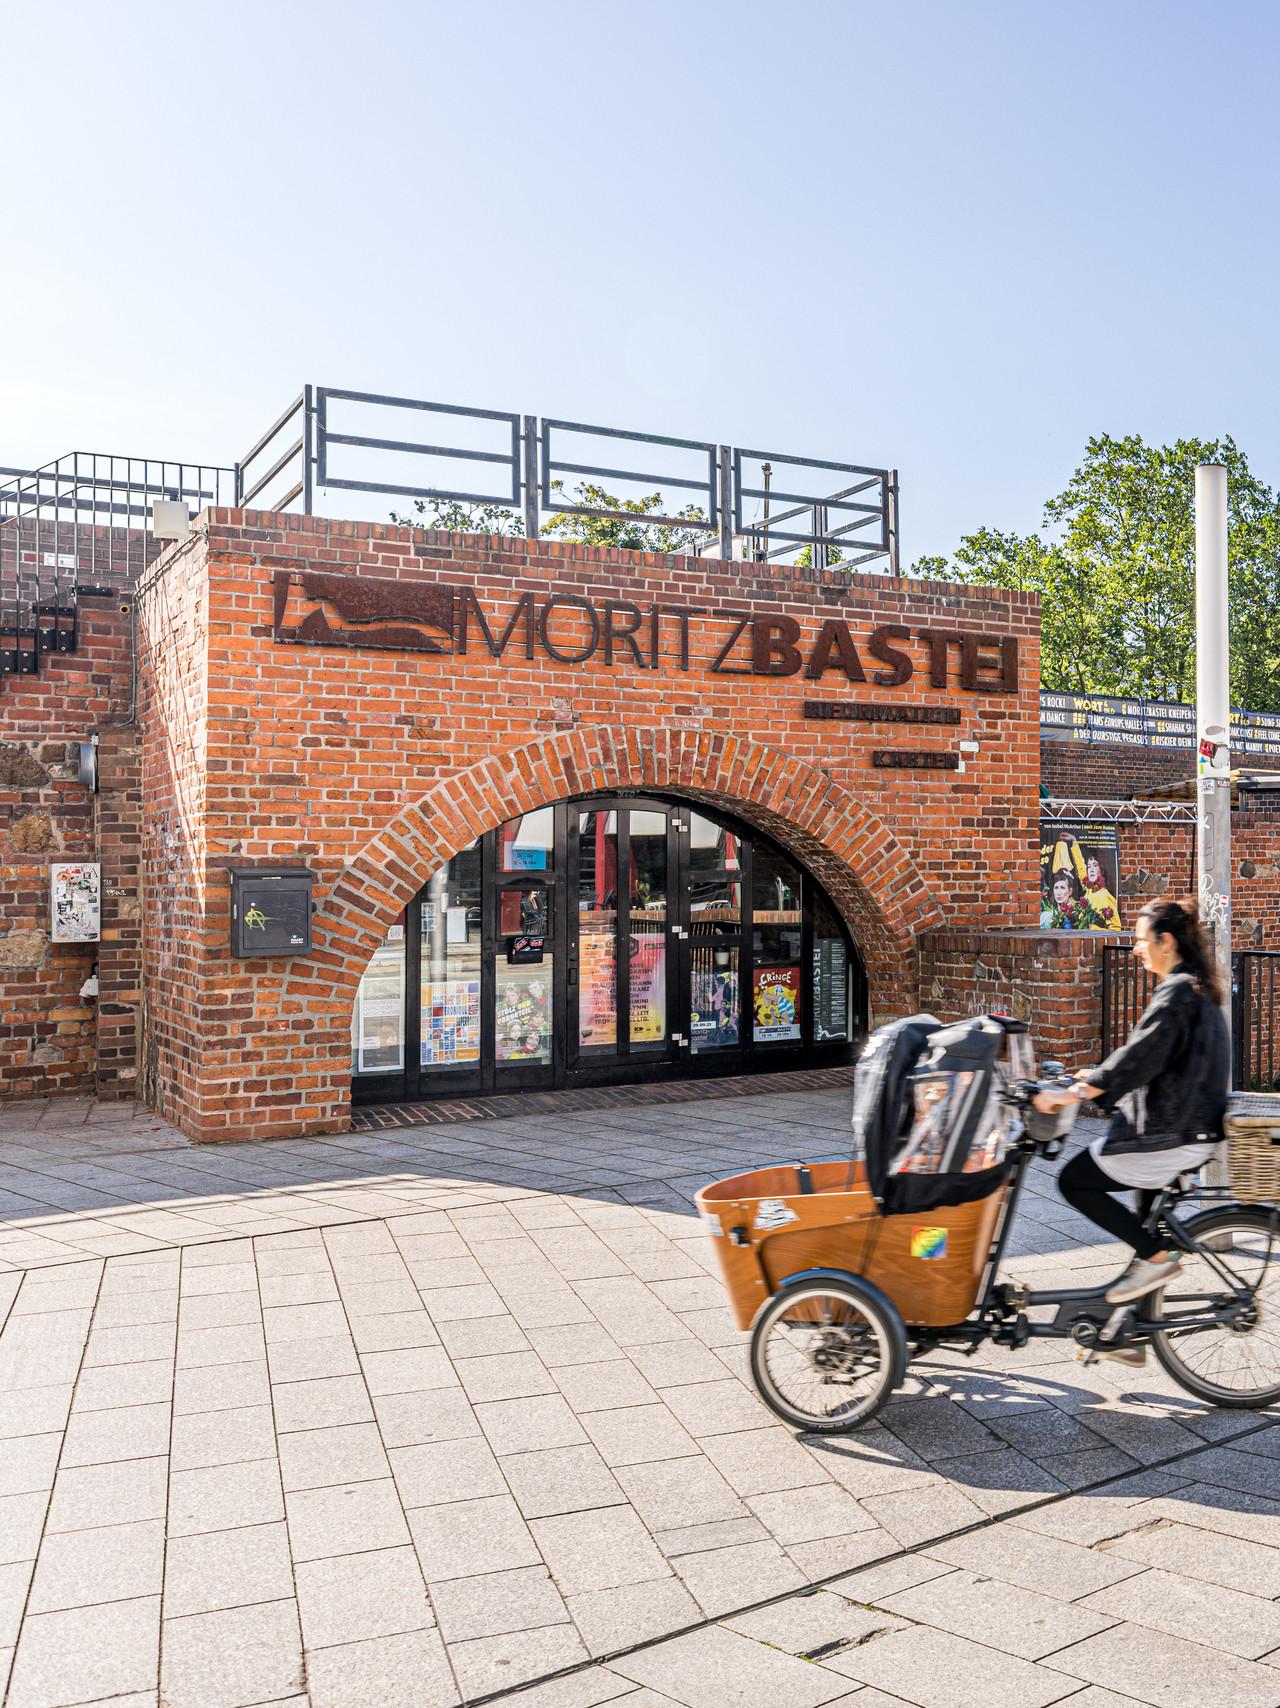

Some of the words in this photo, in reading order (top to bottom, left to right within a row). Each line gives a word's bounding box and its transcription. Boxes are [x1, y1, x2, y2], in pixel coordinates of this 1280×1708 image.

[458, 586, 1019, 693] MORITZBASTEI
[804, 702, 960, 723] INFORMATION
[1073, 697, 1103, 712] WORT
[1229, 713, 1240, 724] RT
[873, 751, 959, 769] KARTEN
